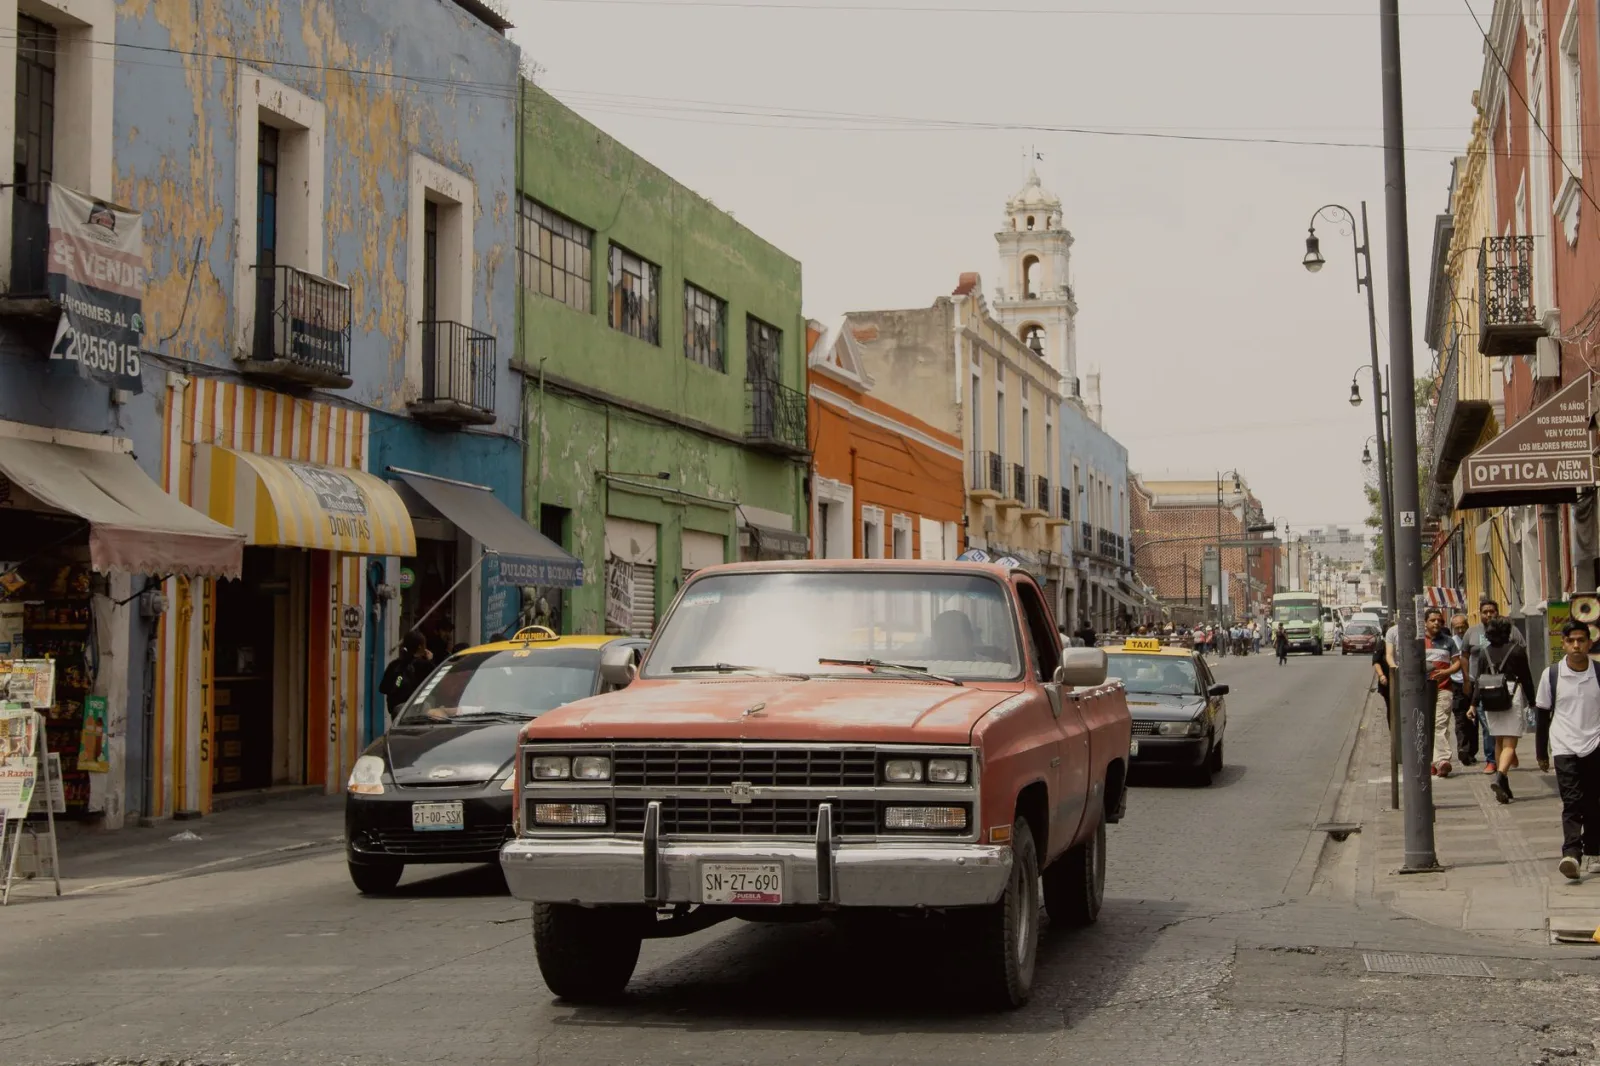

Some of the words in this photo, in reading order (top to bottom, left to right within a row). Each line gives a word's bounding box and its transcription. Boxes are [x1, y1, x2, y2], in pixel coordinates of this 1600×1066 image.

[54, 239, 76, 271] SE
[81, 249, 143, 290] VENDE
[114, 312, 128, 328] AL
[1559, 403, 1567, 411] 16
[1568, 400, 1585, 411] AÑOS
[1537, 416, 1550, 425] NOS
[1551, 415, 1586, 424] RESPALDAN
[1544, 429, 1558, 438] VEN
[1558, 428, 1563, 437] Y
[1564, 428, 1587, 437] COTIZA
[1519, 443, 1531, 451] LOS
[1532, 441, 1560, 450] MEJORES
[1561, 440, 1587, 449] PRECIOS
[1474, 462, 1549, 482] OPTICA
[1552, 463, 1588, 480] VISION
[1559, 460, 1581, 470] NEW
[328, 515, 371, 540] DONITAS
[500, 562, 538, 578] DULCES
[1132, 641, 1152, 649] TAXI
[200, 576, 212, 762] DONITAS
[330, 584, 338, 742] DONITAS
[7, 769, 34, 777] Razón
[705, 873, 779, 891] SN-27-690
